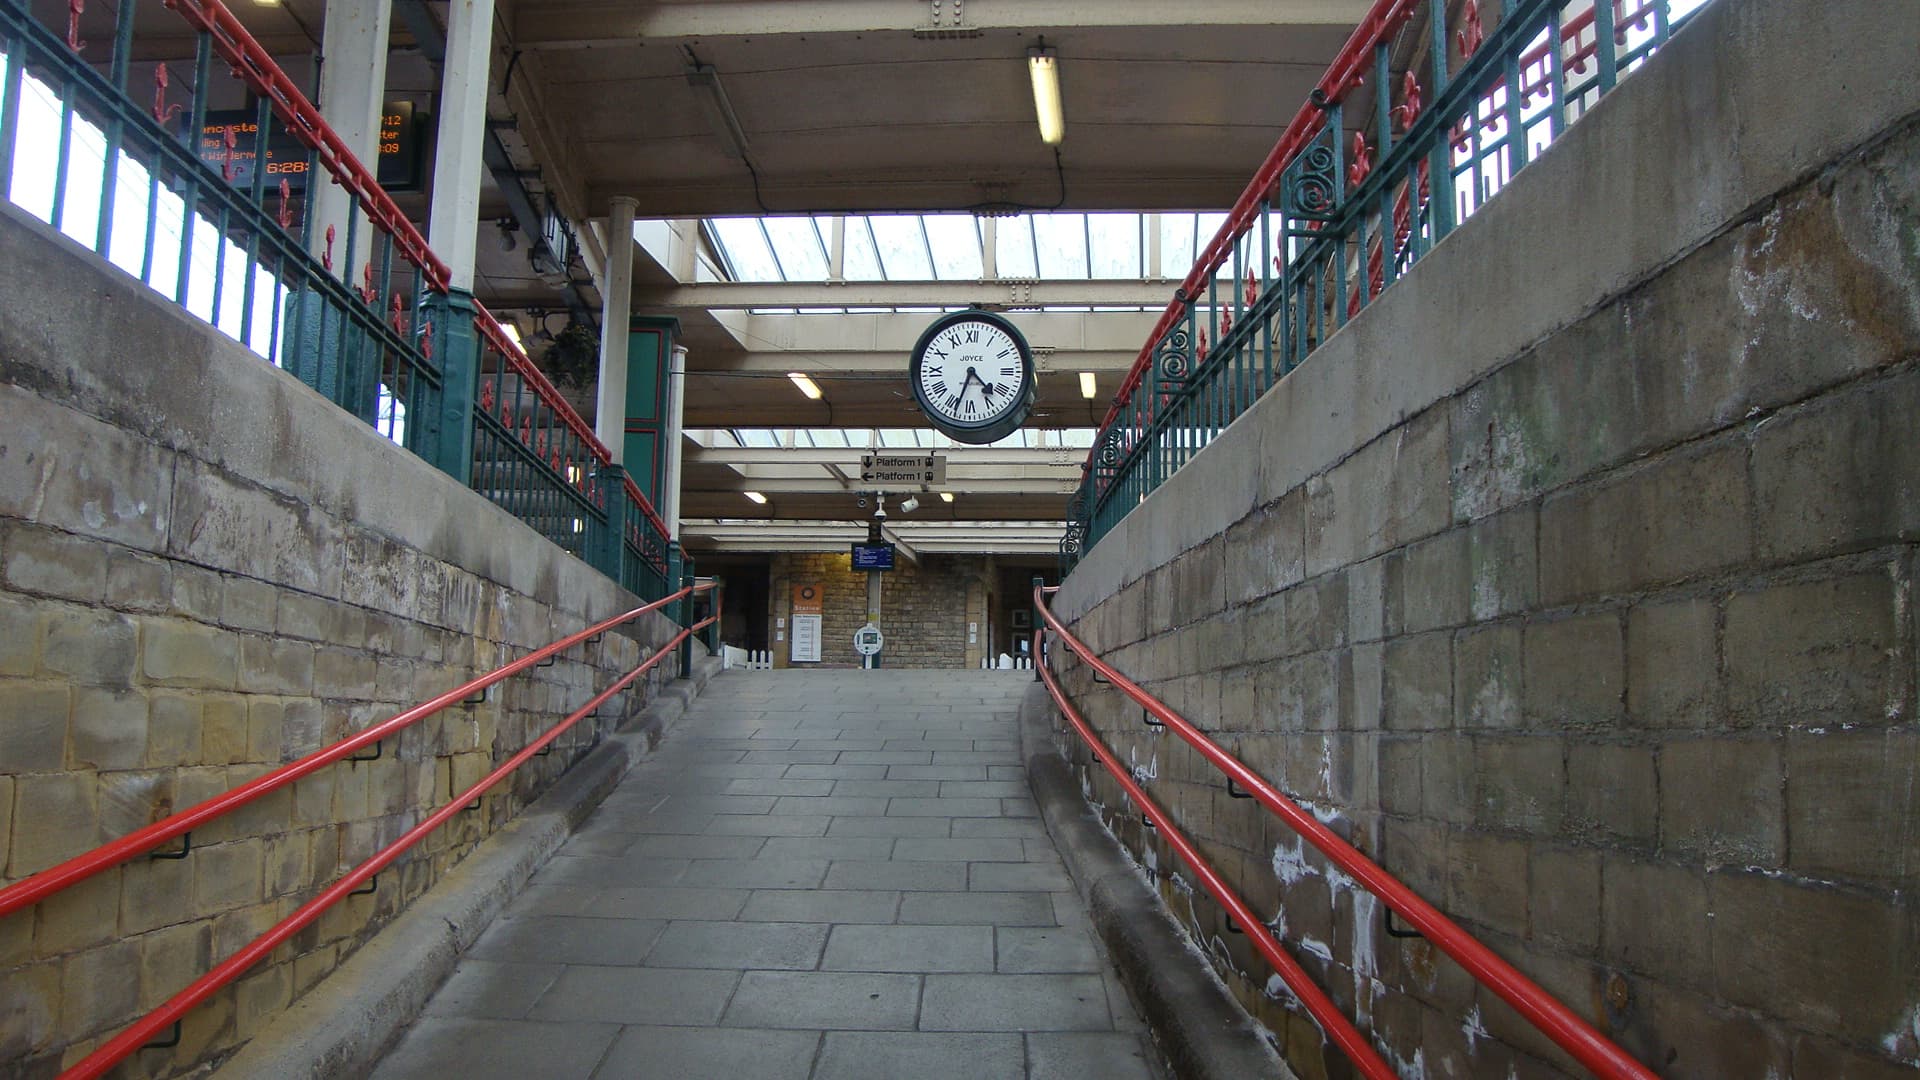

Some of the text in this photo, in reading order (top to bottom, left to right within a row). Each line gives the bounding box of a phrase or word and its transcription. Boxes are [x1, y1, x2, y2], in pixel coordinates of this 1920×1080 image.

[948, 334, 962, 349] XI
[966, 330, 979, 343] XII
[987, 336, 995, 347] I
[934, 349, 948, 360] X
[996, 349, 1010, 359] II
[929, 366, 942, 377] IX
[1000, 368, 1014, 376] III
[931, 381, 947, 398] VIII
[994, 383, 1010, 397] IIII
[965, 400, 976, 413] VI
[876, 458, 915, 467] Platform
[876, 472, 915, 481] Platform
